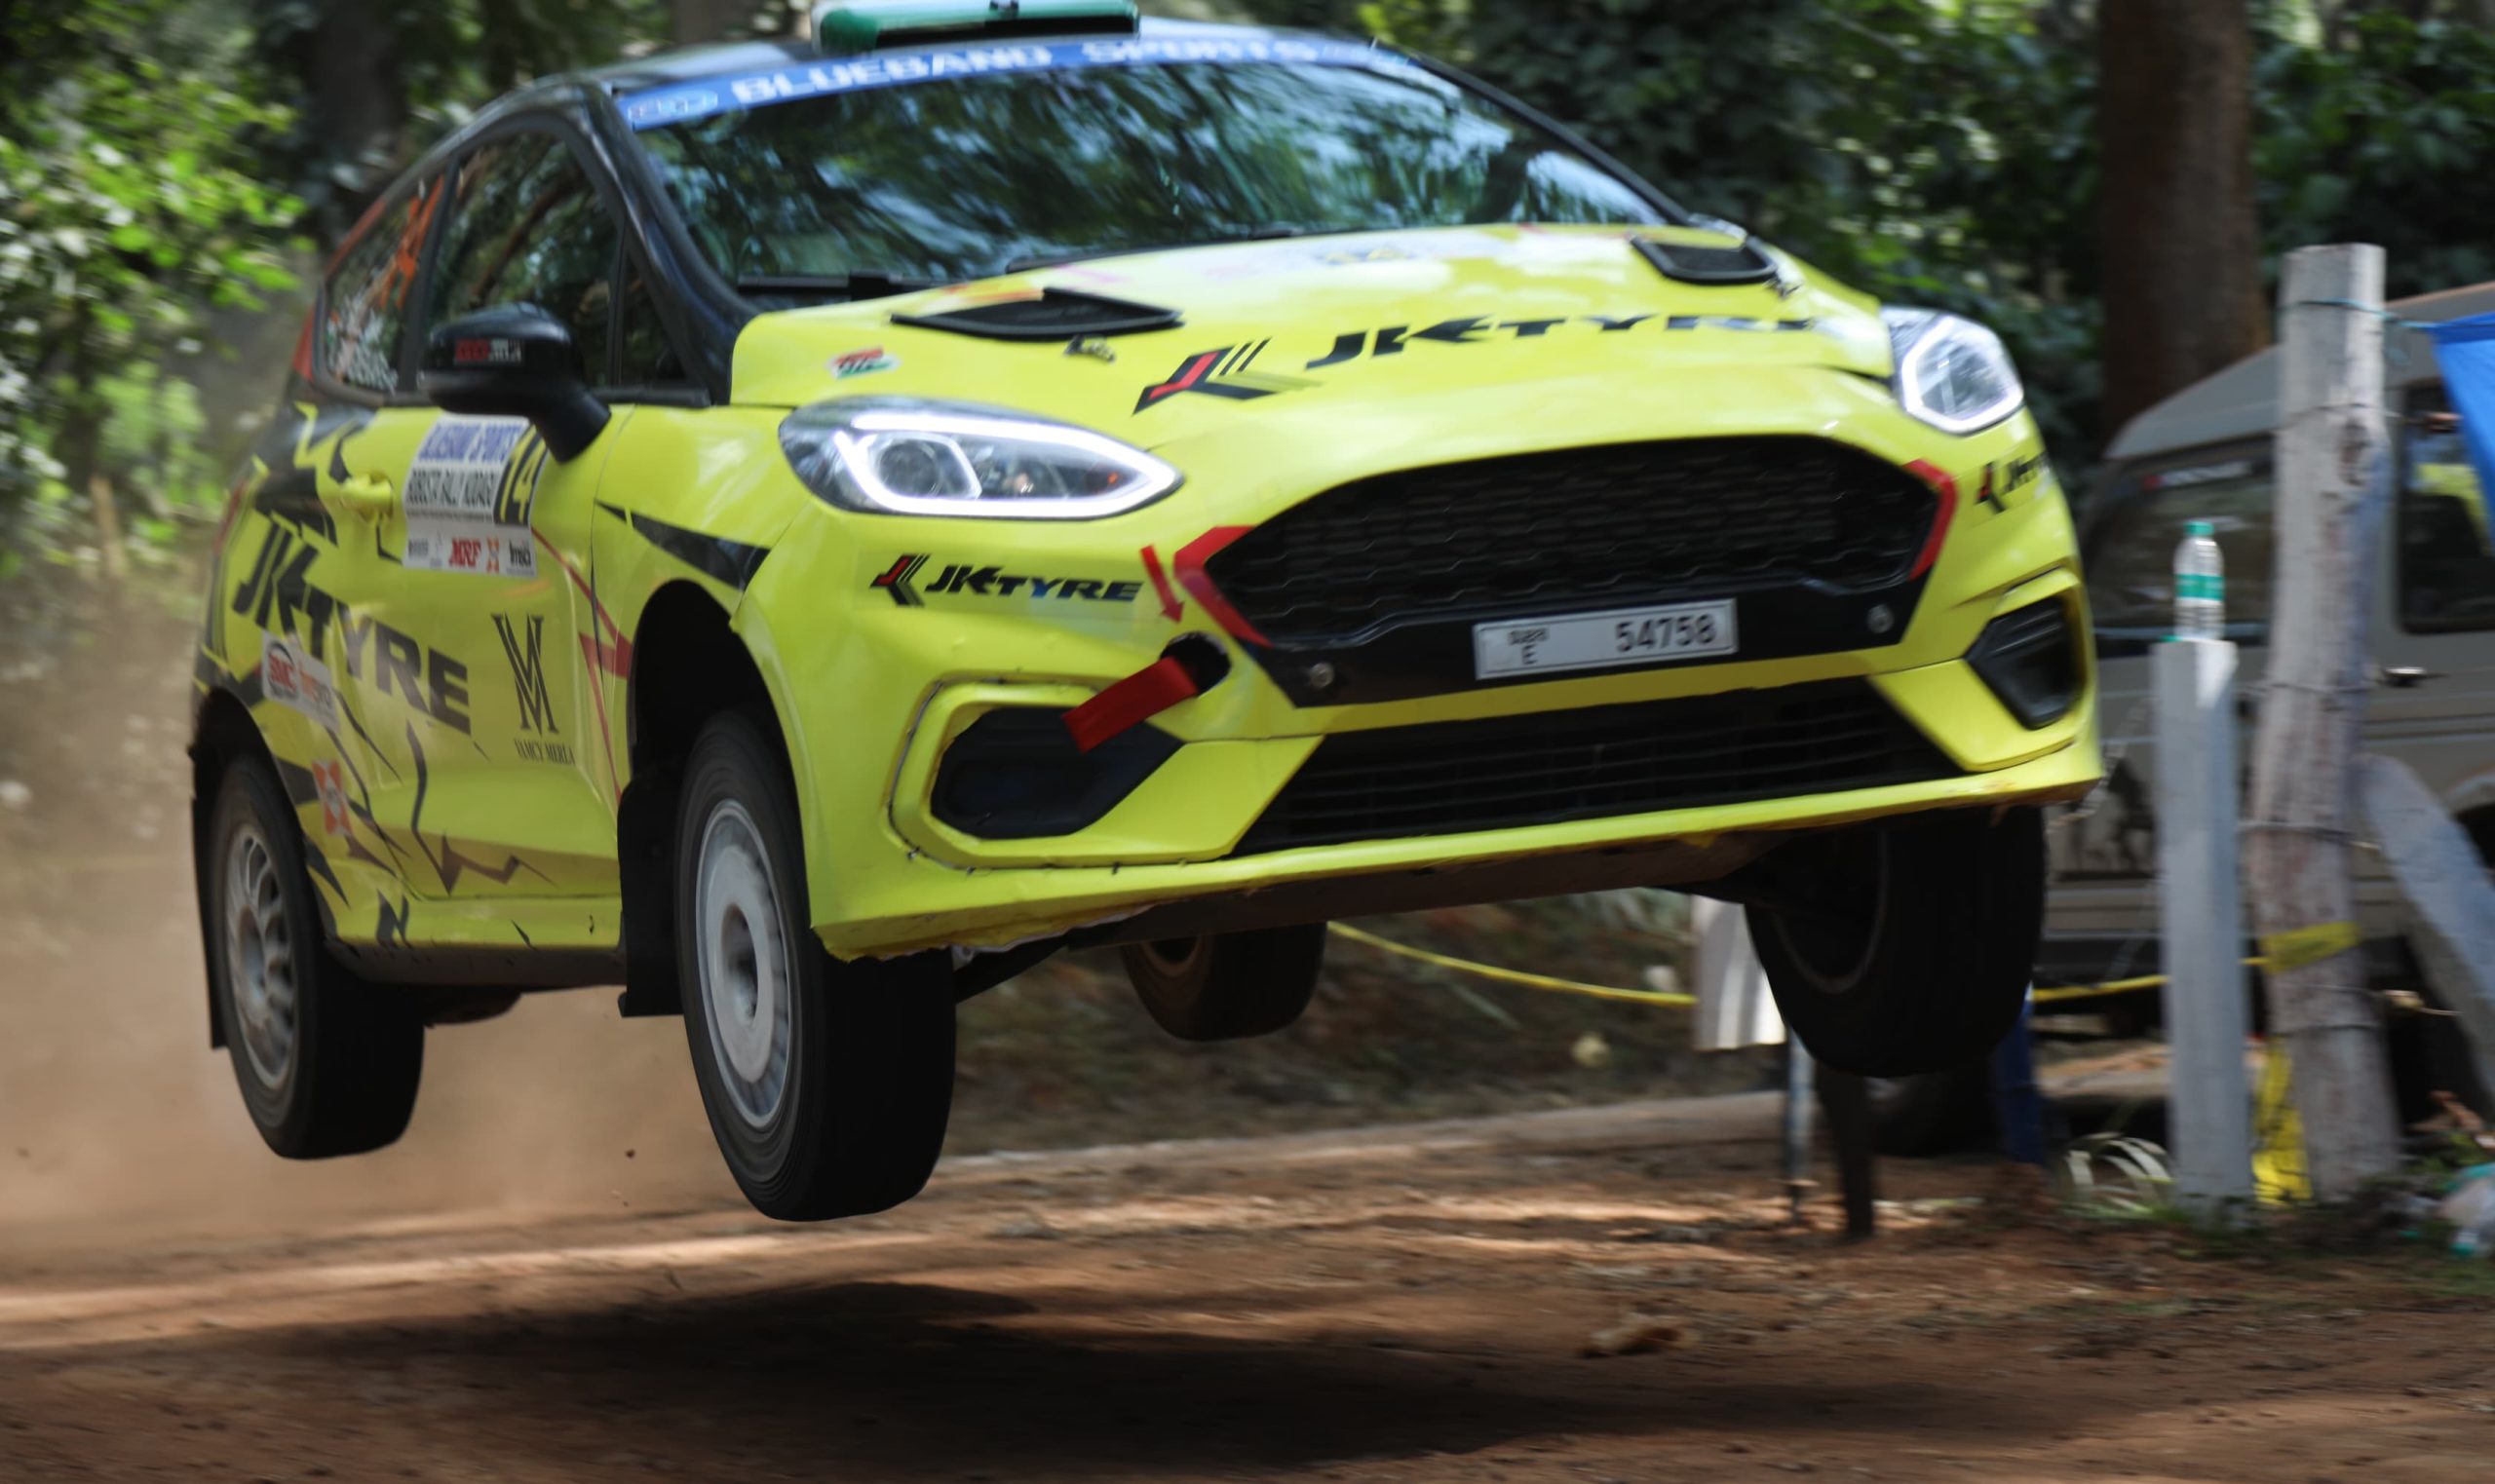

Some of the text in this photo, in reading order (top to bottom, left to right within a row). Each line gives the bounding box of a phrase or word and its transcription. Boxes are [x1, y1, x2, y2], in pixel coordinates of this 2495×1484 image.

[448, 536, 481, 568] MRF
[1616, 614, 1716, 653] 54758
[1521, 643, 1538, 665] E
